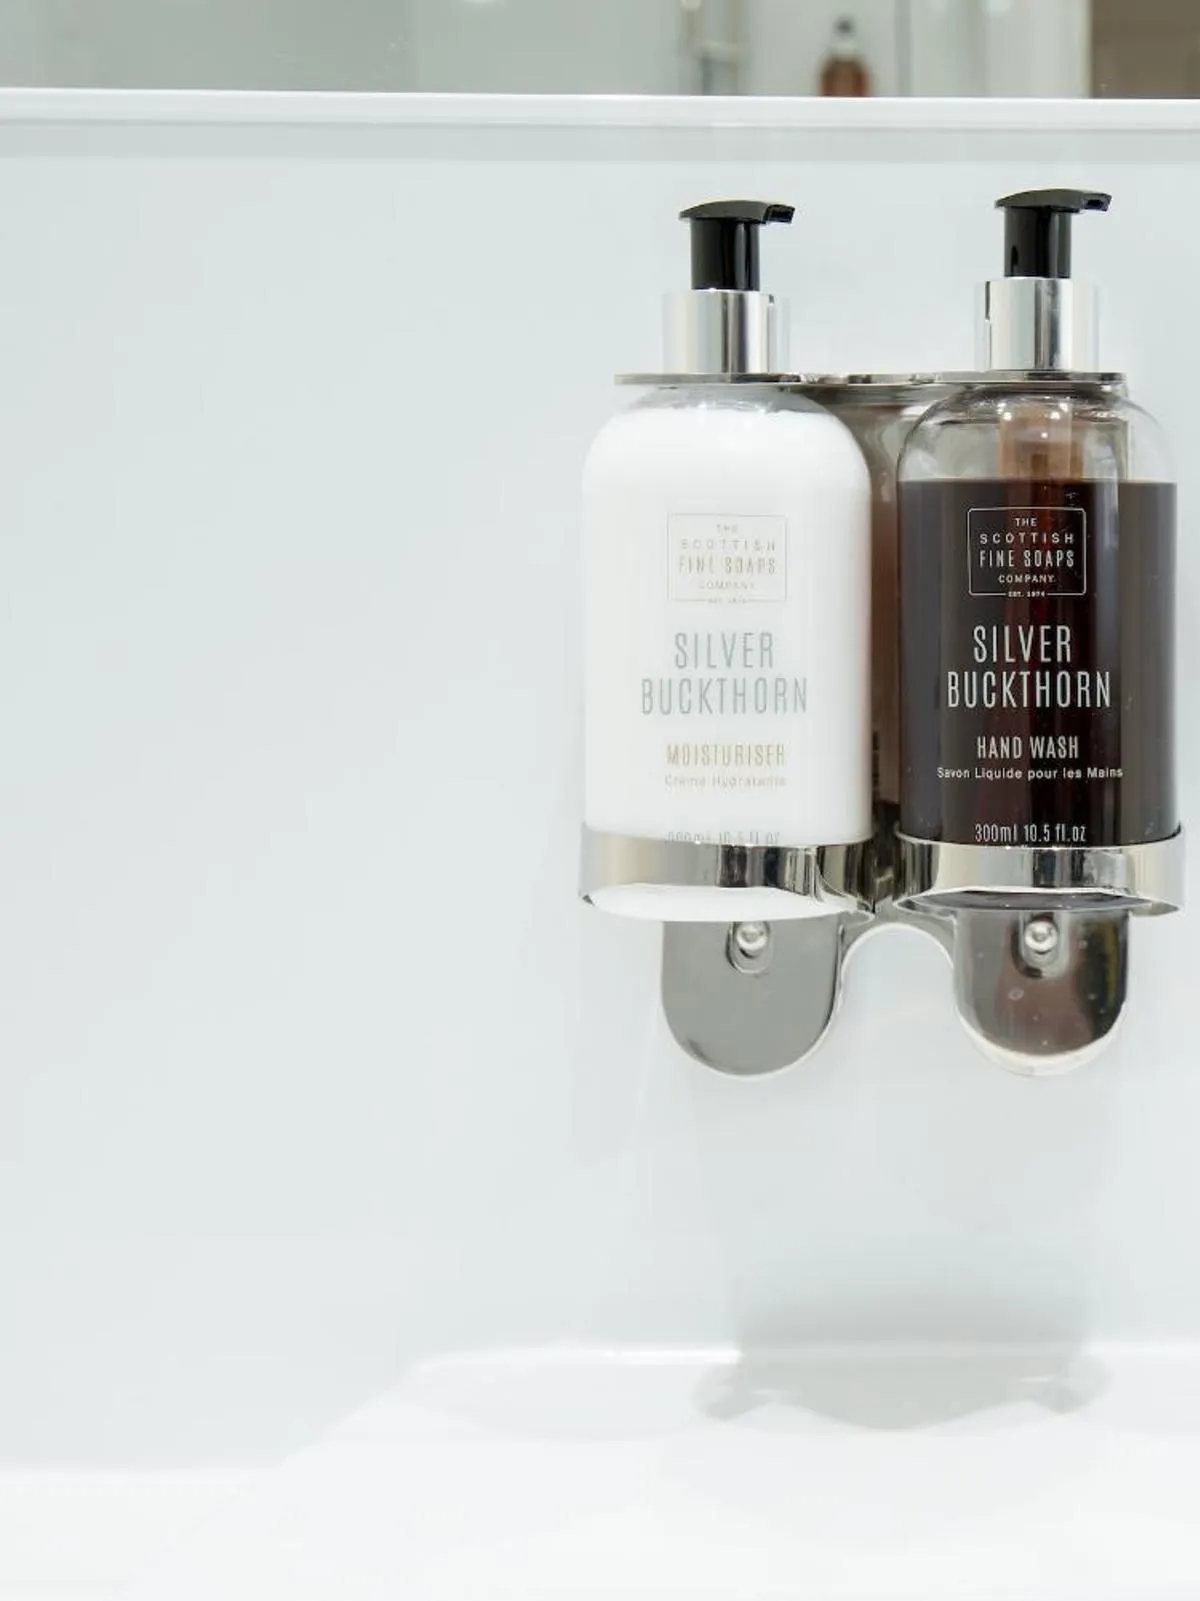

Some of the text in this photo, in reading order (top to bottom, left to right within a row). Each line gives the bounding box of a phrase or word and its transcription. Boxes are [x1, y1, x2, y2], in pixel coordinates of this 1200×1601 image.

[1015, 517, 1037, 527] THE
[681, 538, 775, 552] SCOTTISH
[979, 532, 1074, 545] SCOTTISH
[679, 556, 776, 575] FINE SOAPS
[979, 550, 1074, 567] FINE SOAPS
[998, 574, 1055, 583] COMPANY
[674, 632, 774, 669] SILVER
[973, 625, 1072, 664] SILVER
[641, 677, 808, 716] BUCKTHORN
[947, 671, 1112, 708] BUCKTHORN
[666, 743, 785, 767] MOISTURISER
[976, 736, 1079, 759] HAND WASH
[936, 767, 1124, 782] Savon Liquide pour les Mains
[975, 824, 1087, 843] 300ml 10.5 fl.oz
